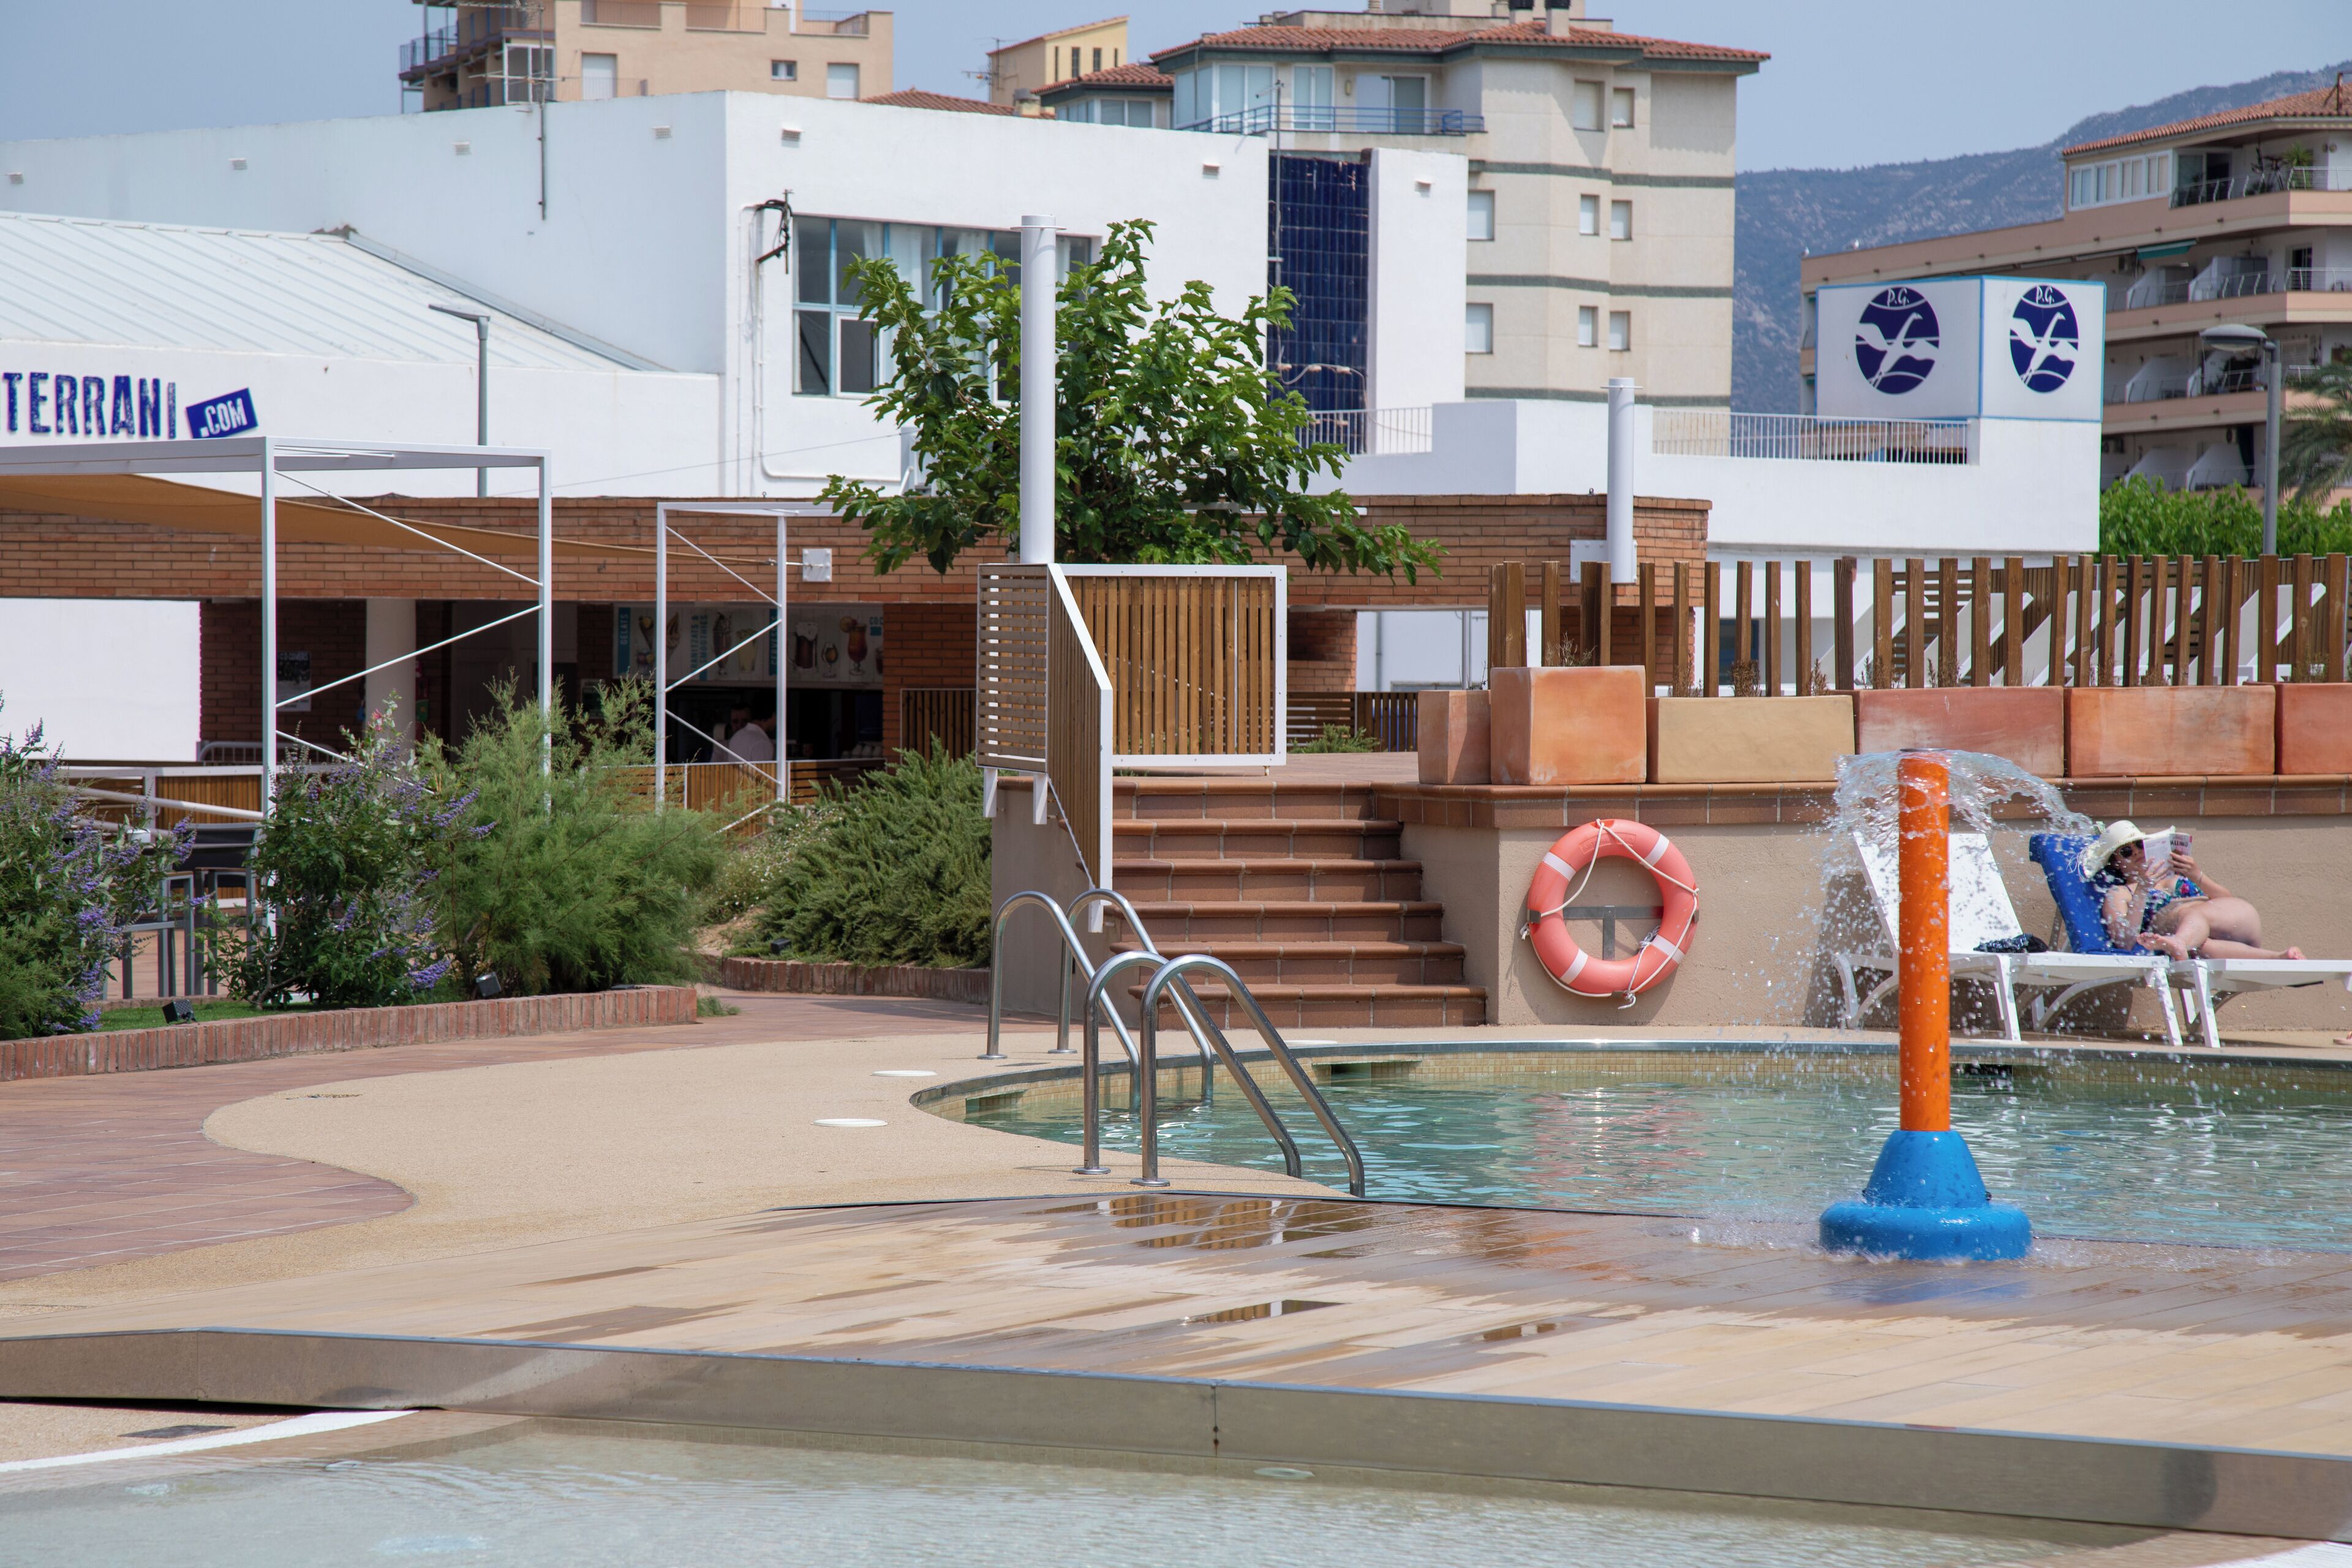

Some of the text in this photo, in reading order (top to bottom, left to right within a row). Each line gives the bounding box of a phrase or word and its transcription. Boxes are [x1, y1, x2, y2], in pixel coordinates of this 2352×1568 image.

[2, 372, 248, 439] TERRANI .COM
[619, 614, 628, 646] GELATS
